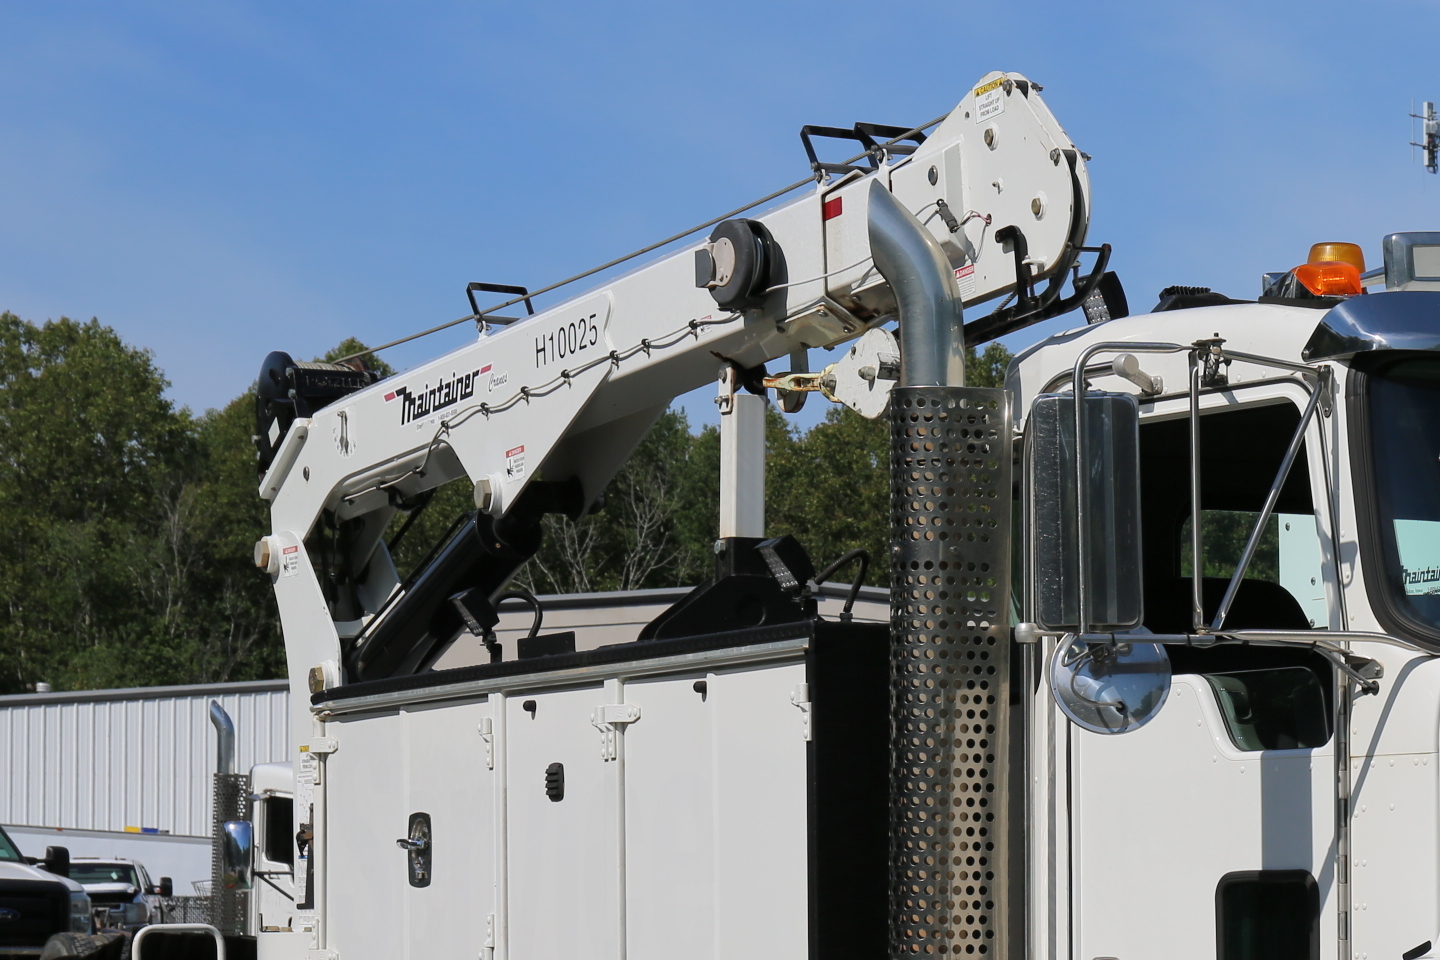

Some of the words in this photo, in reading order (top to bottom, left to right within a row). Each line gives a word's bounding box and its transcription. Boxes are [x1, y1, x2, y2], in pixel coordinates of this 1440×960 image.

[980, 81, 998, 93] CAUTION
[990, 105, 999, 113] LOAD
[535, 313, 598, 368] H10025
